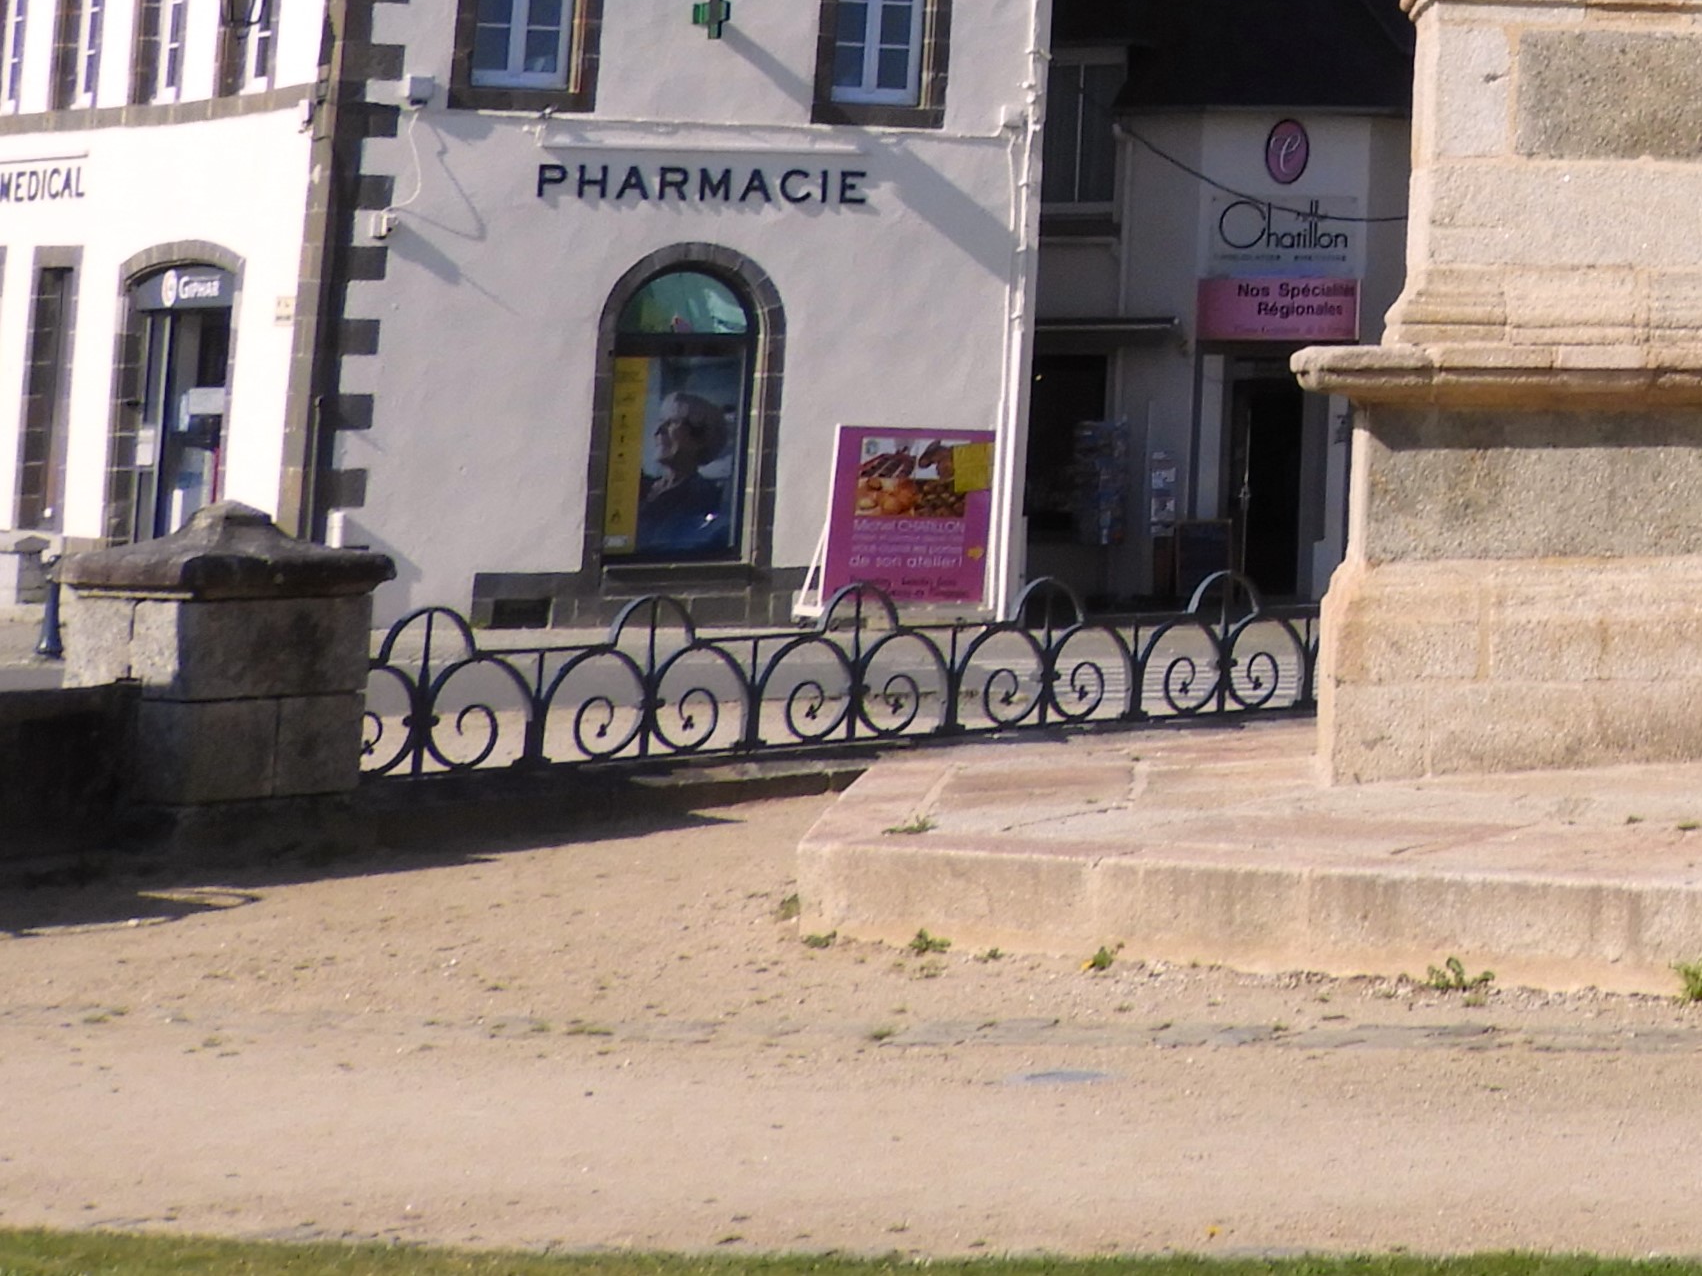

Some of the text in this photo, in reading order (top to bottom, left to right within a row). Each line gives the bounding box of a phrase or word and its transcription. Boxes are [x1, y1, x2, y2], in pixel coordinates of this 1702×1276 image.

[0, 166, 85, 203] MEDICAL
[537, 163, 868, 204] PHARMACIE
[1219, 199, 1348, 248] Chatillon
[1237, 283, 1270, 297] Nos
[1257, 301, 1343, 319] Régionales
[848, 554, 870, 567] de
[876, 556, 902, 567] son
